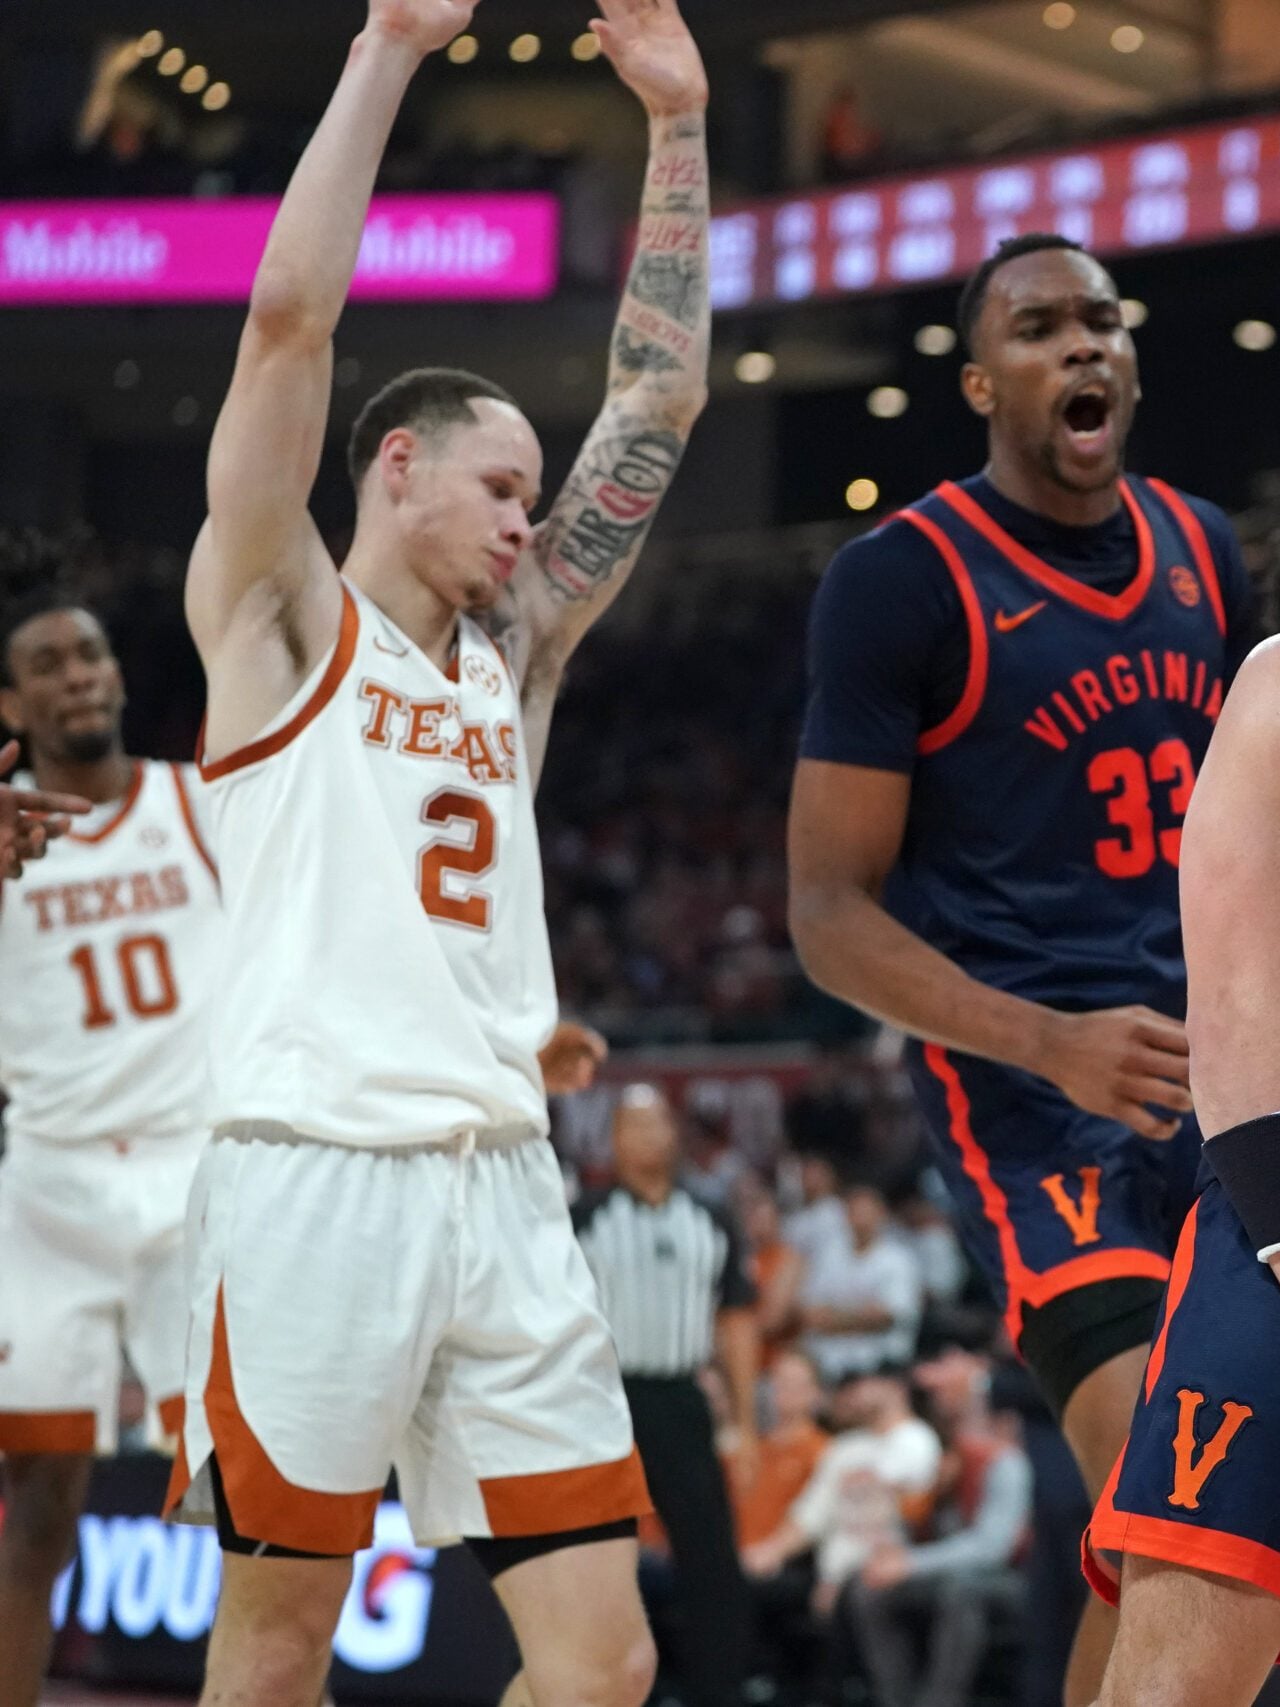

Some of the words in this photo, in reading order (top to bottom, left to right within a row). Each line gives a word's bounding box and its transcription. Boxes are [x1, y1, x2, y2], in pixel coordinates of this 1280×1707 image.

[5, 219, 168, 282] Mobile
[596, 430, 690, 520] GOD
[1024, 650, 1223, 751] VIRGINIA
[1087, 738, 1197, 879] 33
[25, 864, 190, 934] TEXAS
[414, 785, 500, 934] 2
[69, 934, 181, 1033] 10
[1040, 1166, 1103, 1247] V
[1168, 1389, 1254, 1510] V
